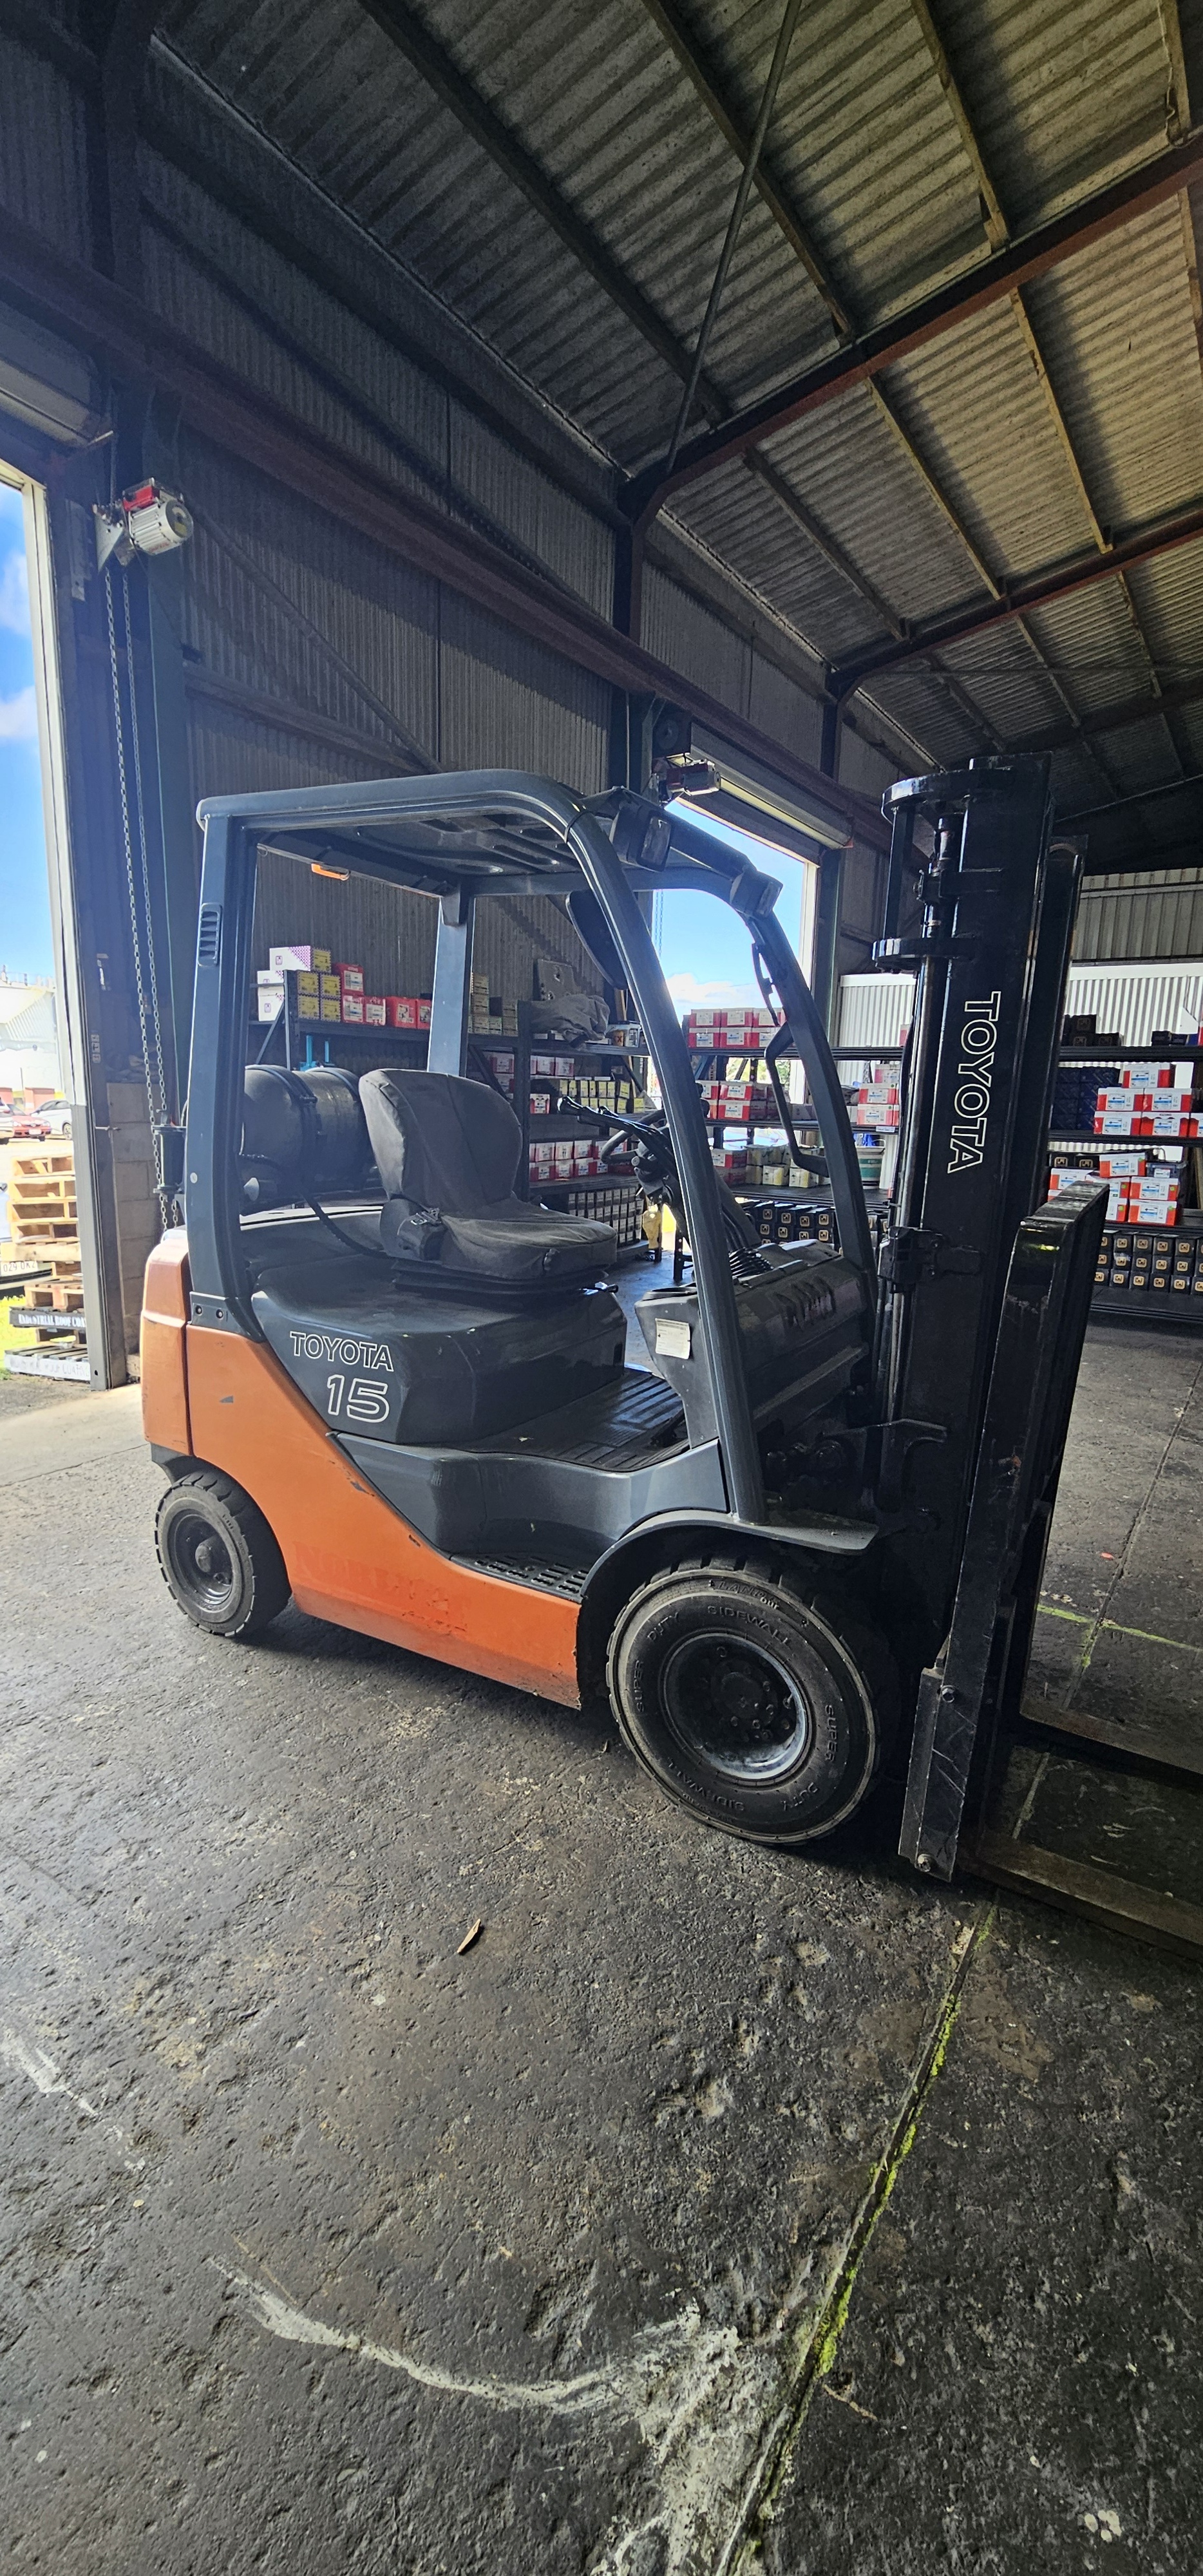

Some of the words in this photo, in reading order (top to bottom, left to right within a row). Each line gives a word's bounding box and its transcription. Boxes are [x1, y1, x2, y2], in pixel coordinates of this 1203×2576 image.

[947, 991, 1001, 1174] TOYOTA
[73, 1316, 86, 1328] COA
[290, 1331, 394, 1372] TOYOTA
[327, 1374, 390, 1423] 15
[634, 1659, 644, 1712] SUPER
[647, 1611, 680, 1642] DUTY
[708, 1605, 789, 1644] SIDEWALL
[825, 1705, 838, 1763] SUPER
[781, 1781, 820, 1812] DUTY
